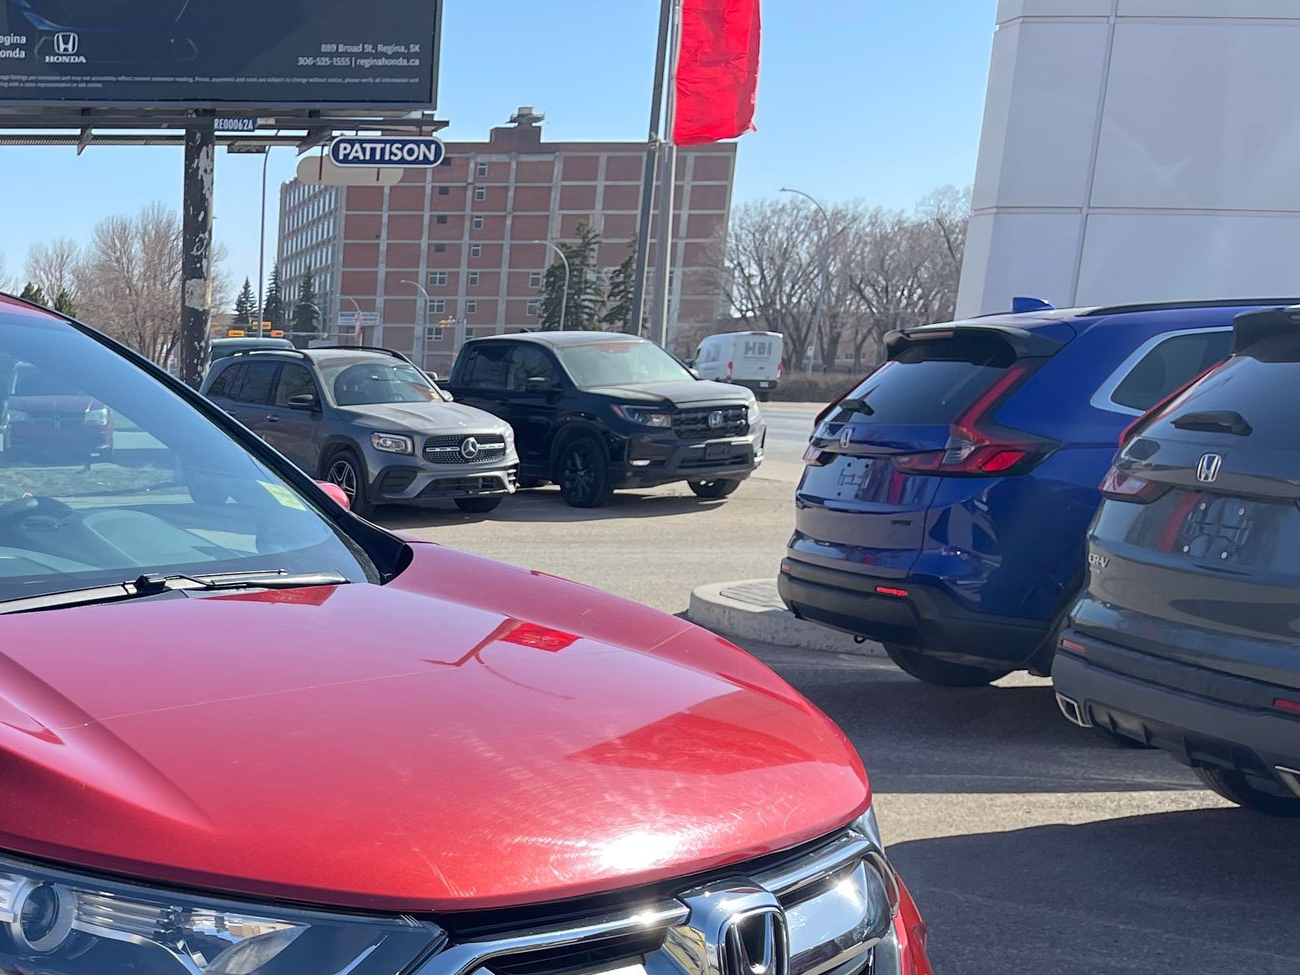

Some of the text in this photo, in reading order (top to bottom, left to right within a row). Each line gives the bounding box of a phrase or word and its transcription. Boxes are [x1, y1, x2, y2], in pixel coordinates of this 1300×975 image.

[338, 43, 363, 53] Broad
[377, 43, 408, 55] Regina,
[45, 55, 87, 63] HONDA
[356, 57, 420, 68] reginahonda.ca
[214, 118, 254, 130] RE00062A
[338, 142, 436, 161] PATTISON
